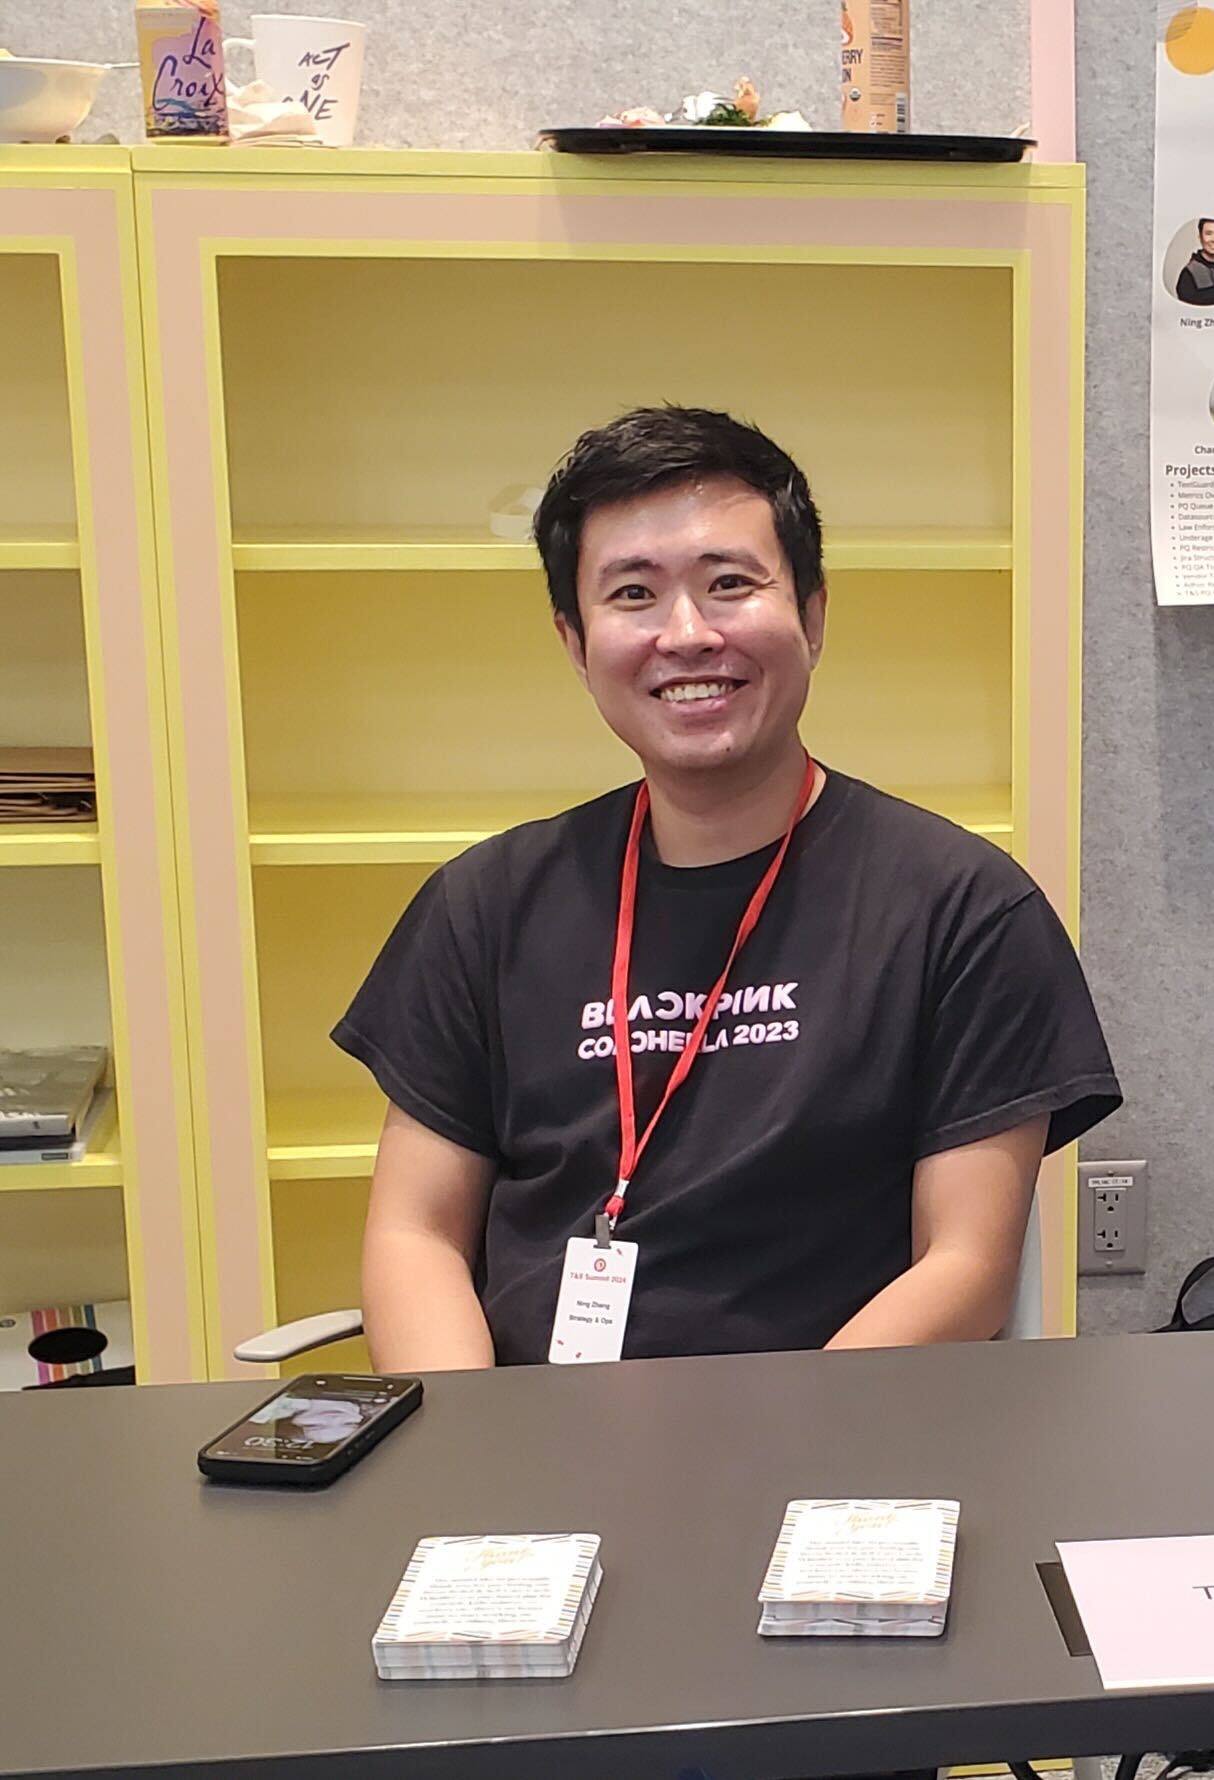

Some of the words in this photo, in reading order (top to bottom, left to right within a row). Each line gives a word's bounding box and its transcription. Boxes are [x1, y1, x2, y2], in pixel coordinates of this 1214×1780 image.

[182, 16, 216, 69] La
[297, 42, 351, 71] ACT
[152, 54, 225, 110] Croix
[310, 73, 330, 91] as
[282, 89, 339, 120] NE
[1180, 318, 1202, 329] Ning
[732, 1020, 799, 1046] 2023
